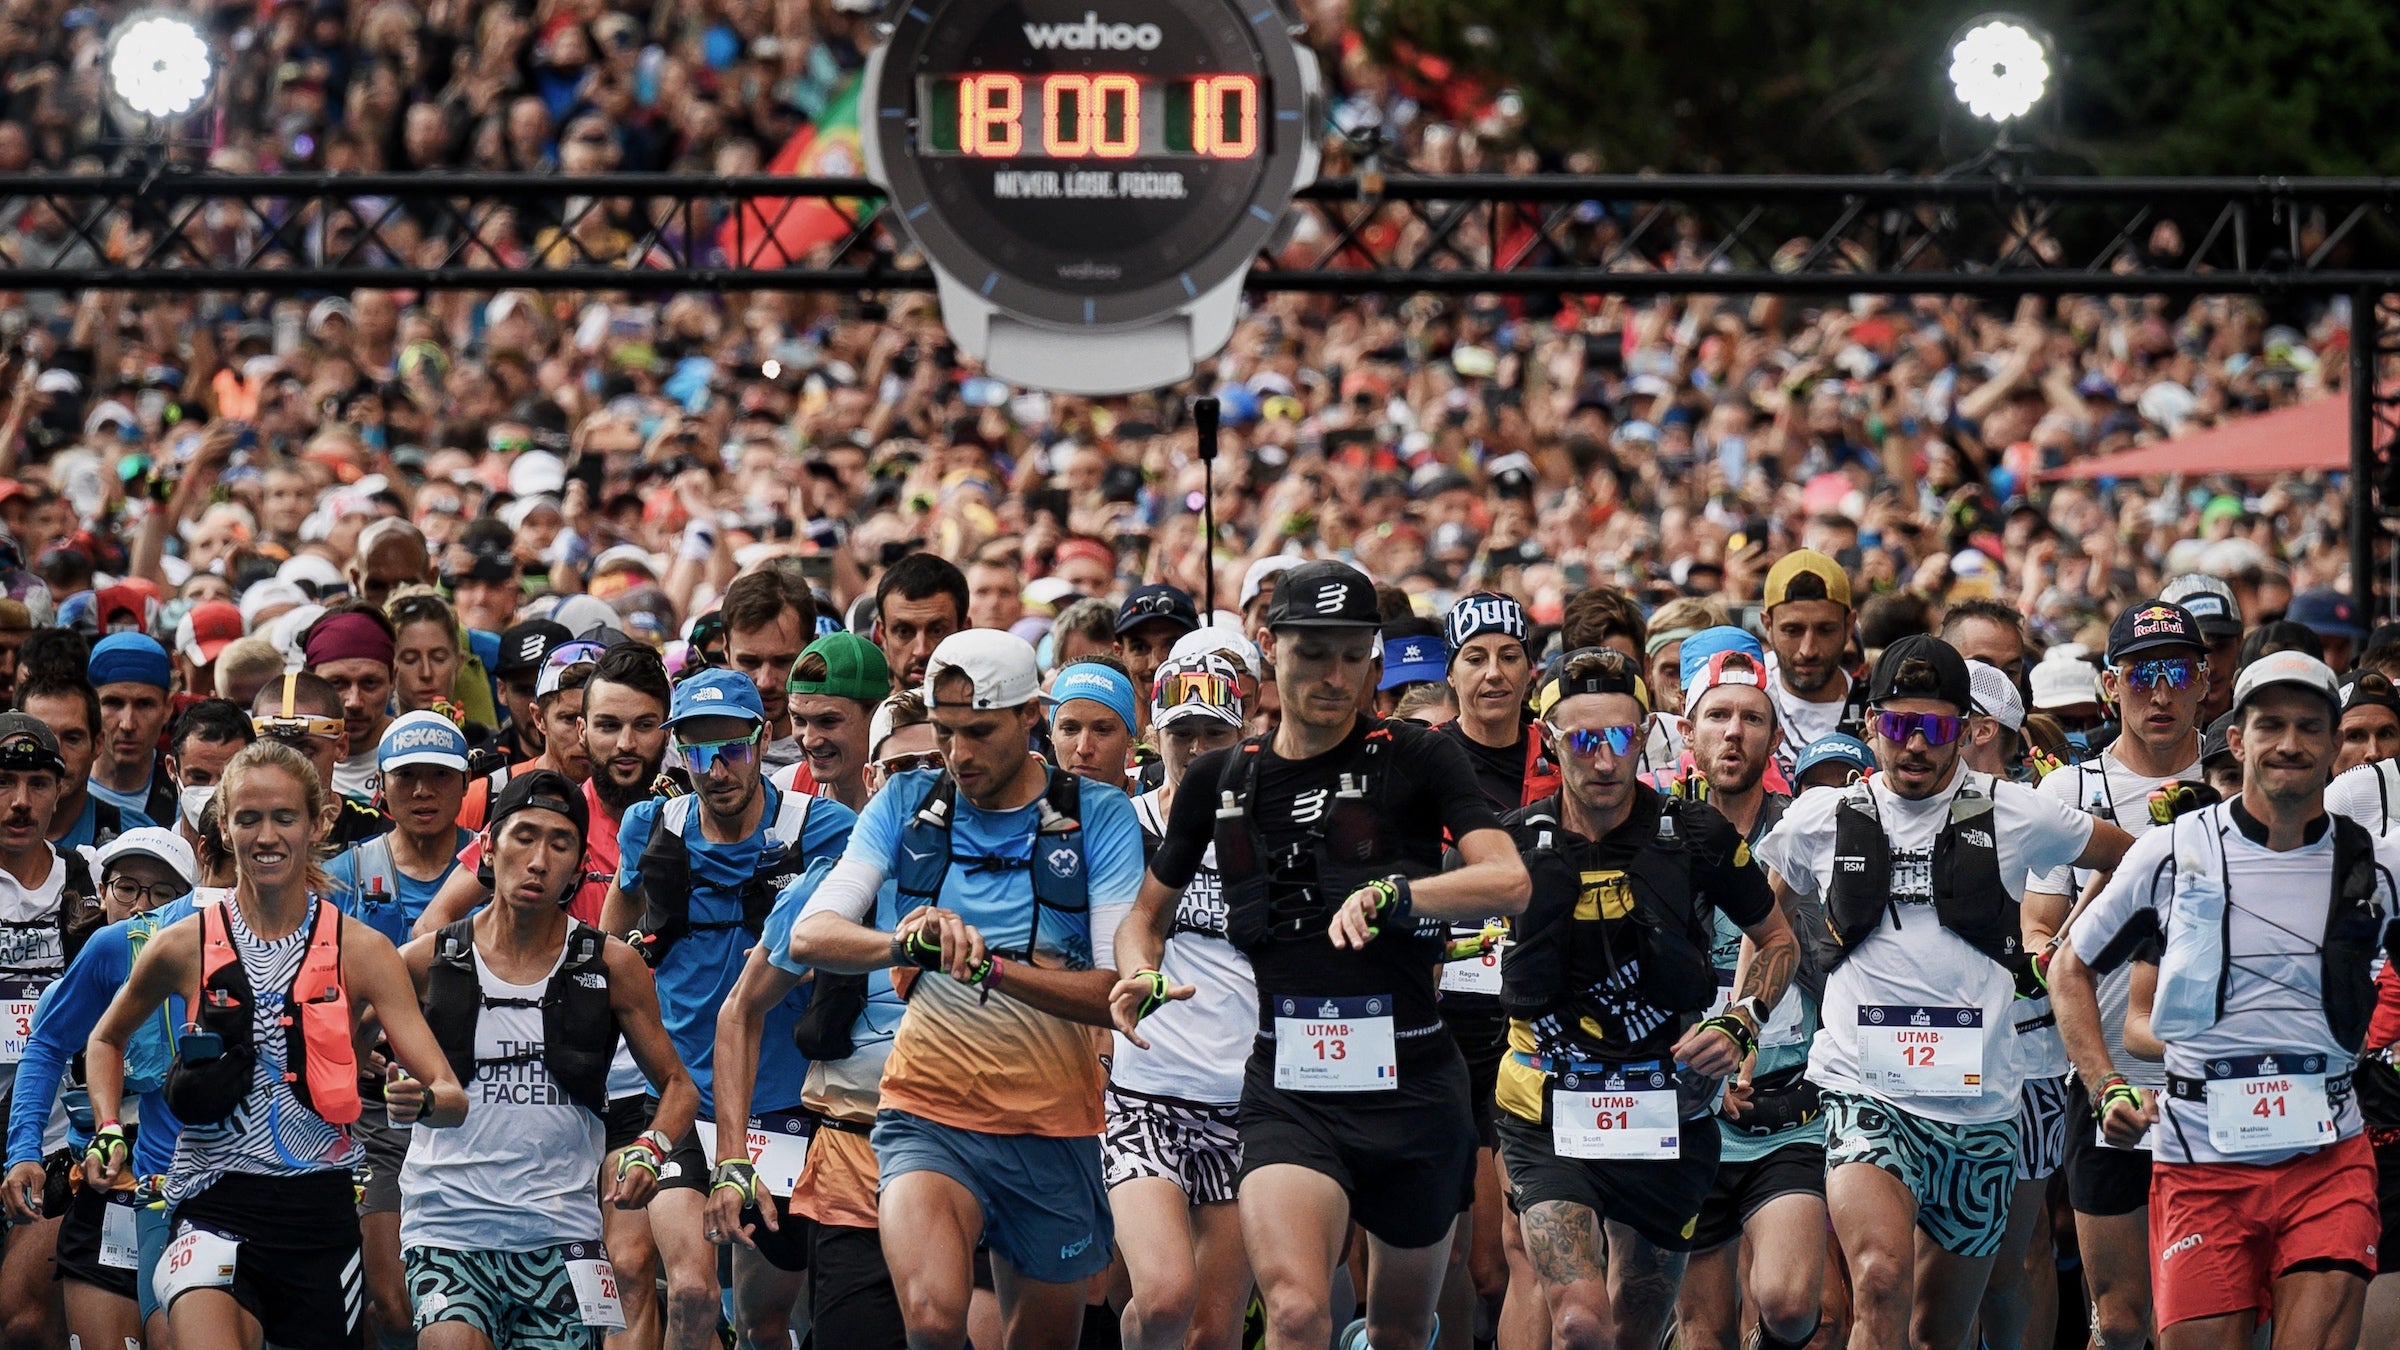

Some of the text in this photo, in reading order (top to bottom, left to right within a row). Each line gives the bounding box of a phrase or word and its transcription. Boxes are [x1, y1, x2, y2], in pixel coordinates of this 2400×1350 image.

[1022, 10, 1162, 50] wahoo
[960, 74, 1257, 158] 18 00 10
[1451, 598, 1524, 644] Buff
[2134, 621, 2184, 637] Red Bull
[393, 728, 437, 752] HOKA
[1810, 742, 1862, 760] HOKA
[1844, 862, 1865, 872] RSM
[1192, 873, 1221, 889] HE
[1178, 907, 1224, 929] ACE
[0, 943, 38, 965] ACE
[1459, 970, 1480, 978] Ragna
[11, 1004, 36, 1014] UTM
[16, 1018, 31, 1036] 3
[1306, 1024, 1349, 1036] UTMB
[1898, 1032, 1939, 1044] UTMB
[497, 1041, 544, 1058] THE
[1313, 1040, 1346, 1060] 13
[1903, 1047, 1935, 1066] 12
[476, 1062, 545, 1082] ORTH
[482, 1084, 544, 1104] FACE
[2246, 1080, 2289, 1096] UTMB
[1592, 1097, 1634, 1108] UTMB
[2252, 1096, 2286, 1118] 41
[1597, 1111, 1628, 1130] 61
[746, 1134, 767, 1146] MB
[749, 1148, 763, 1164] 7
[170, 1250, 192, 1275] 50
[601, 1279, 616, 1299] 28
